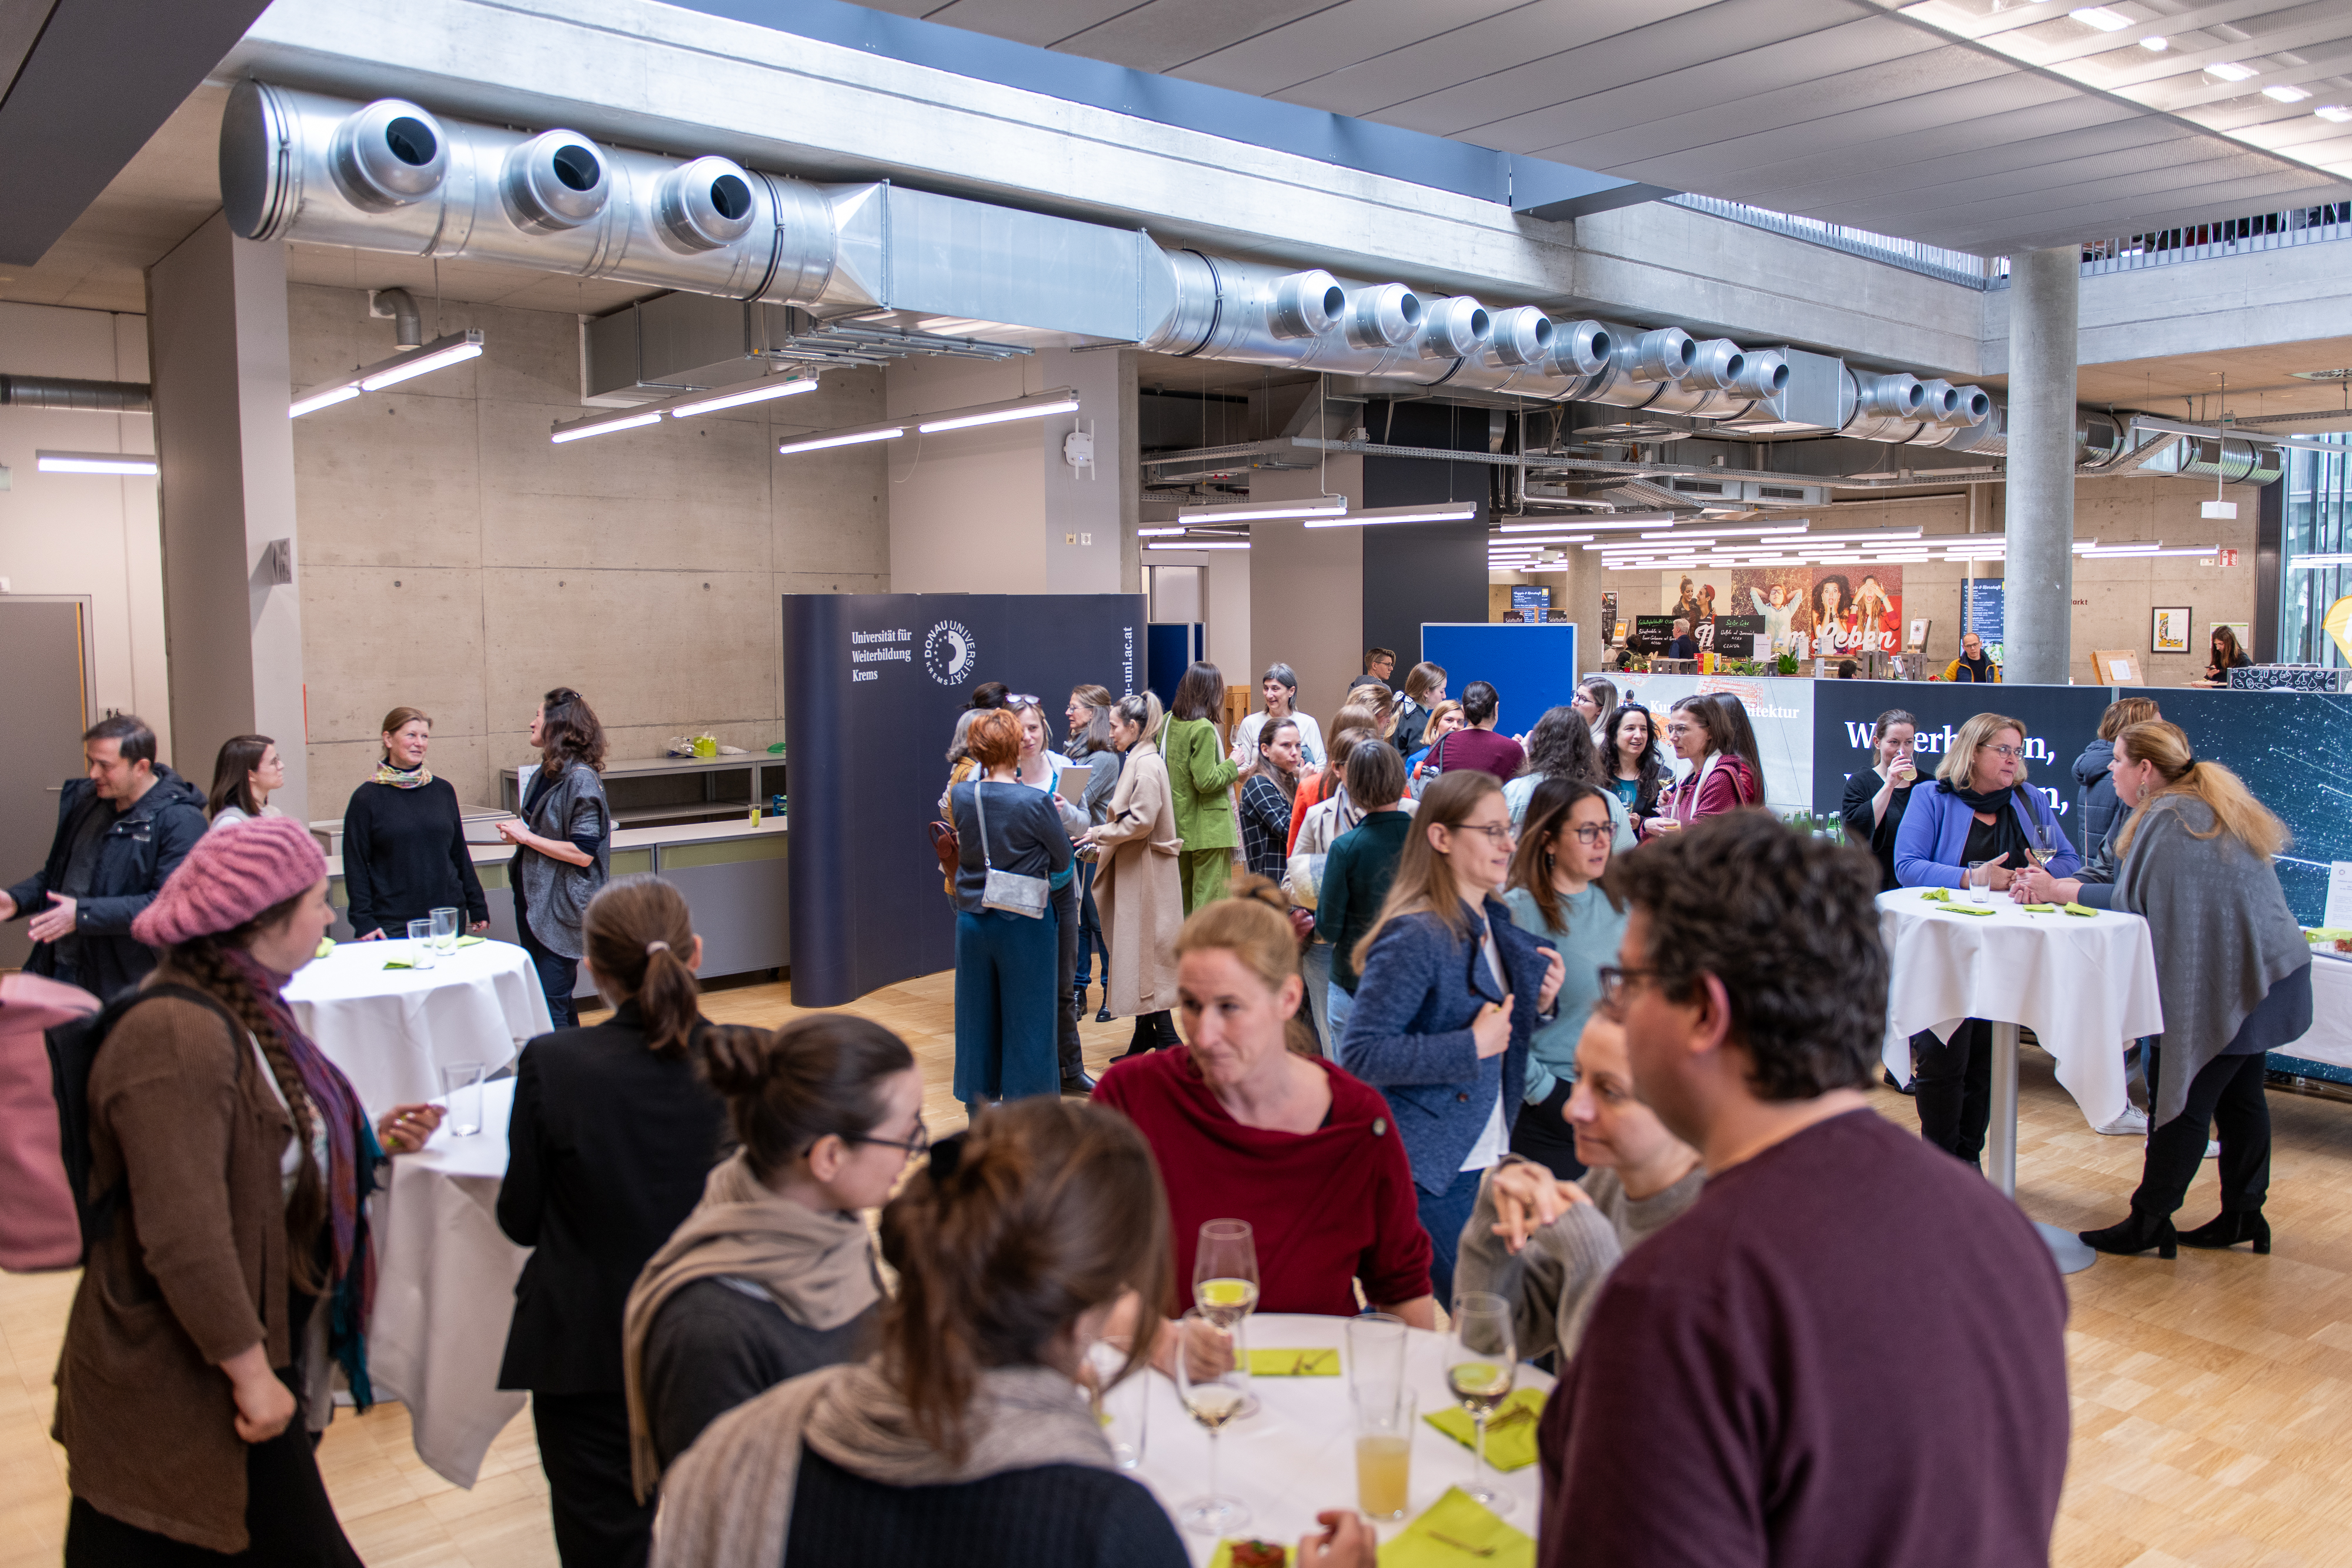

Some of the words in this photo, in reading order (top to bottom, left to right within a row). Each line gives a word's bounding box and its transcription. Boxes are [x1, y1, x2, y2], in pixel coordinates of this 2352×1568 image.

[851, 630, 896, 644] Universität
[897, 628, 912, 641] für
[924, 620, 948, 658] DONAU
[1812, 622, 1896, 649] Leben
[851, 647, 911, 663] Weiterbildung
[949, 620, 976, 686] UNIVERSITÄT
[852, 669, 878, 682] Krems
[926, 661, 948, 686] KREMS
